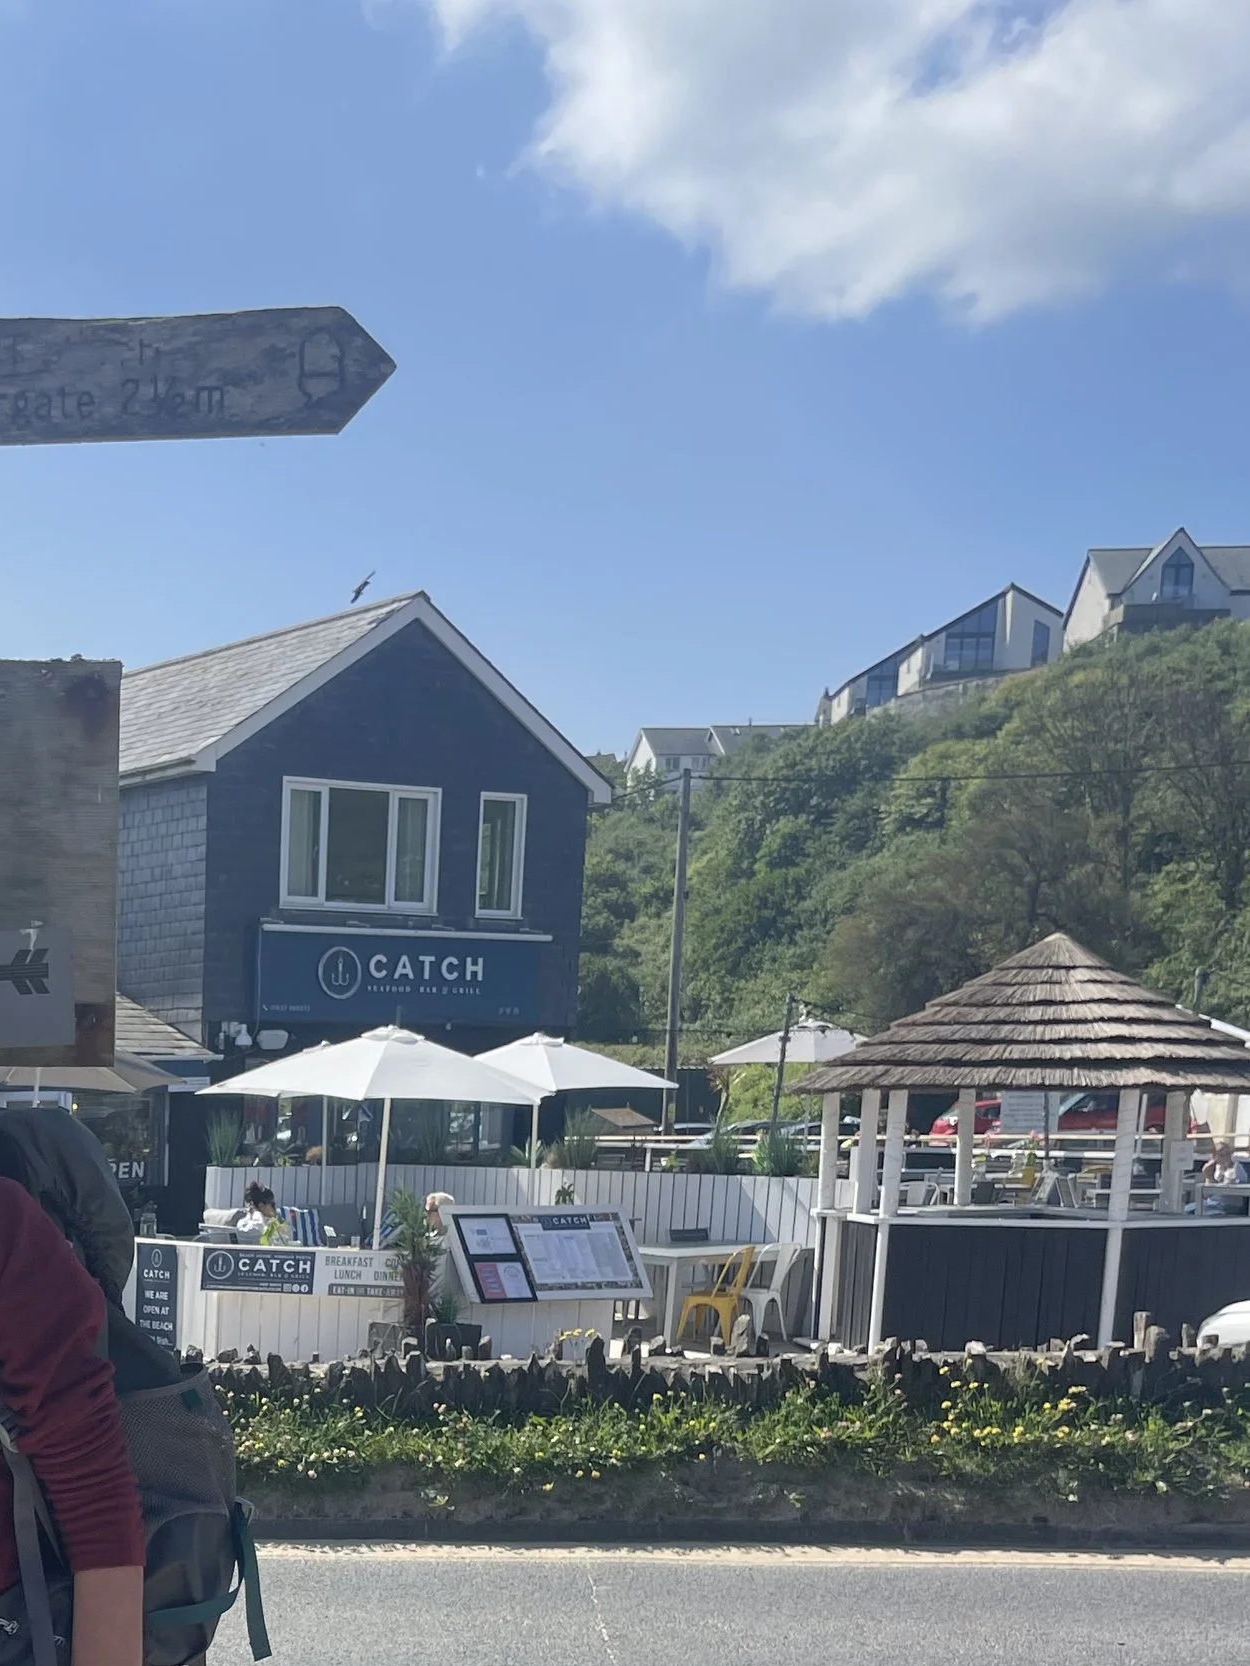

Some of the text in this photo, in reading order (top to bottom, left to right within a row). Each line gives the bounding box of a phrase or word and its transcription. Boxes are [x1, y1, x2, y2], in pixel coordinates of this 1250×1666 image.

[368, 954, 484, 981] CATCH
[367, 985, 411, 994] SEAFOOD
[419, 985, 438, 994] BAR
[451, 987, 481, 995] GRILL
[109, 1161, 145, 1179] PEN
[552, 1216, 588, 1225] CATCH
[238, 1258, 310, 1274] CATCH
[325, 1255, 374, 1268] BREAKFAST
[143, 1268, 170, 1280] CATCH
[334, 1269, 362, 1280] LUNCH
[144, 1289, 169, 1301] WE ARE
[142, 1305, 170, 1315] OPEN AT
[139, 1319, 173, 1331] THE BEACH
